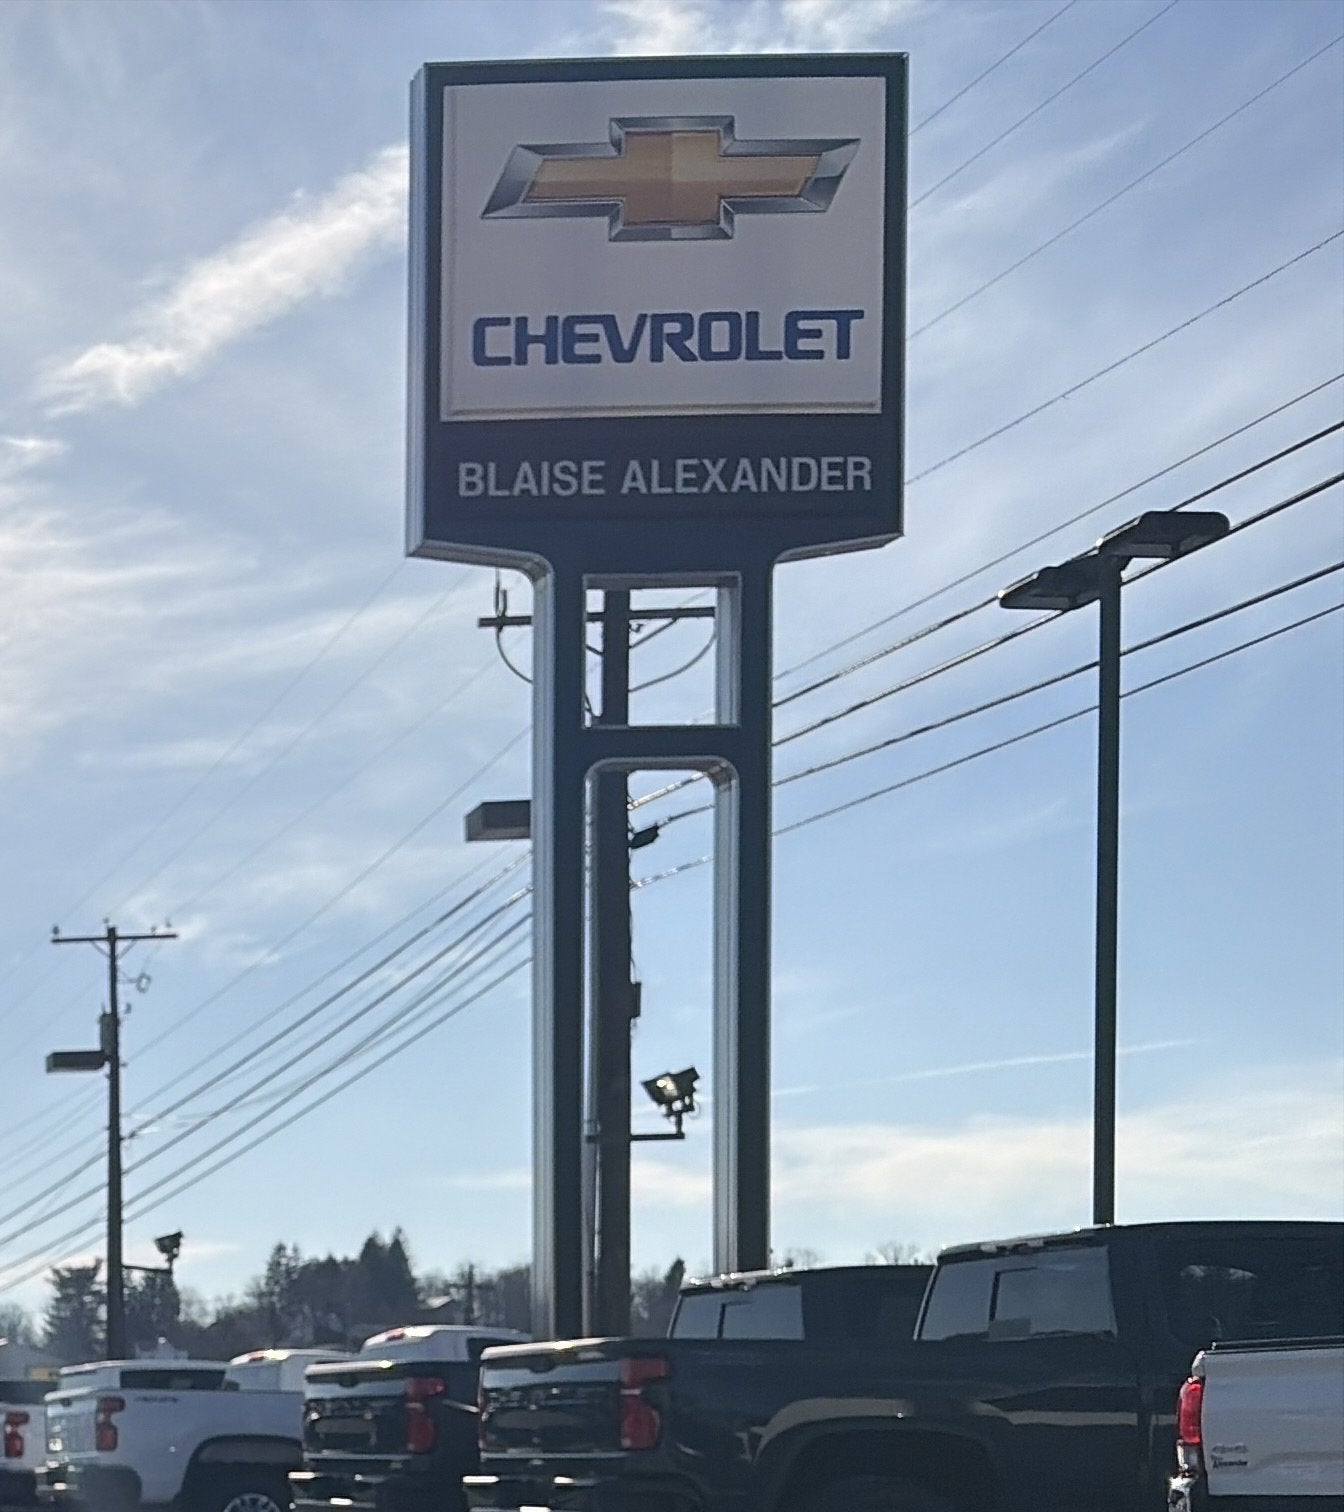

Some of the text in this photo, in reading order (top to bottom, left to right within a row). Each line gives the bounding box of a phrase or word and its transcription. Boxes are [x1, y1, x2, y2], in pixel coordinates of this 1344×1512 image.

[472, 310, 864, 366] CHEVROLET
[459, 456, 872, 496] BLAISE ALEXANDER
